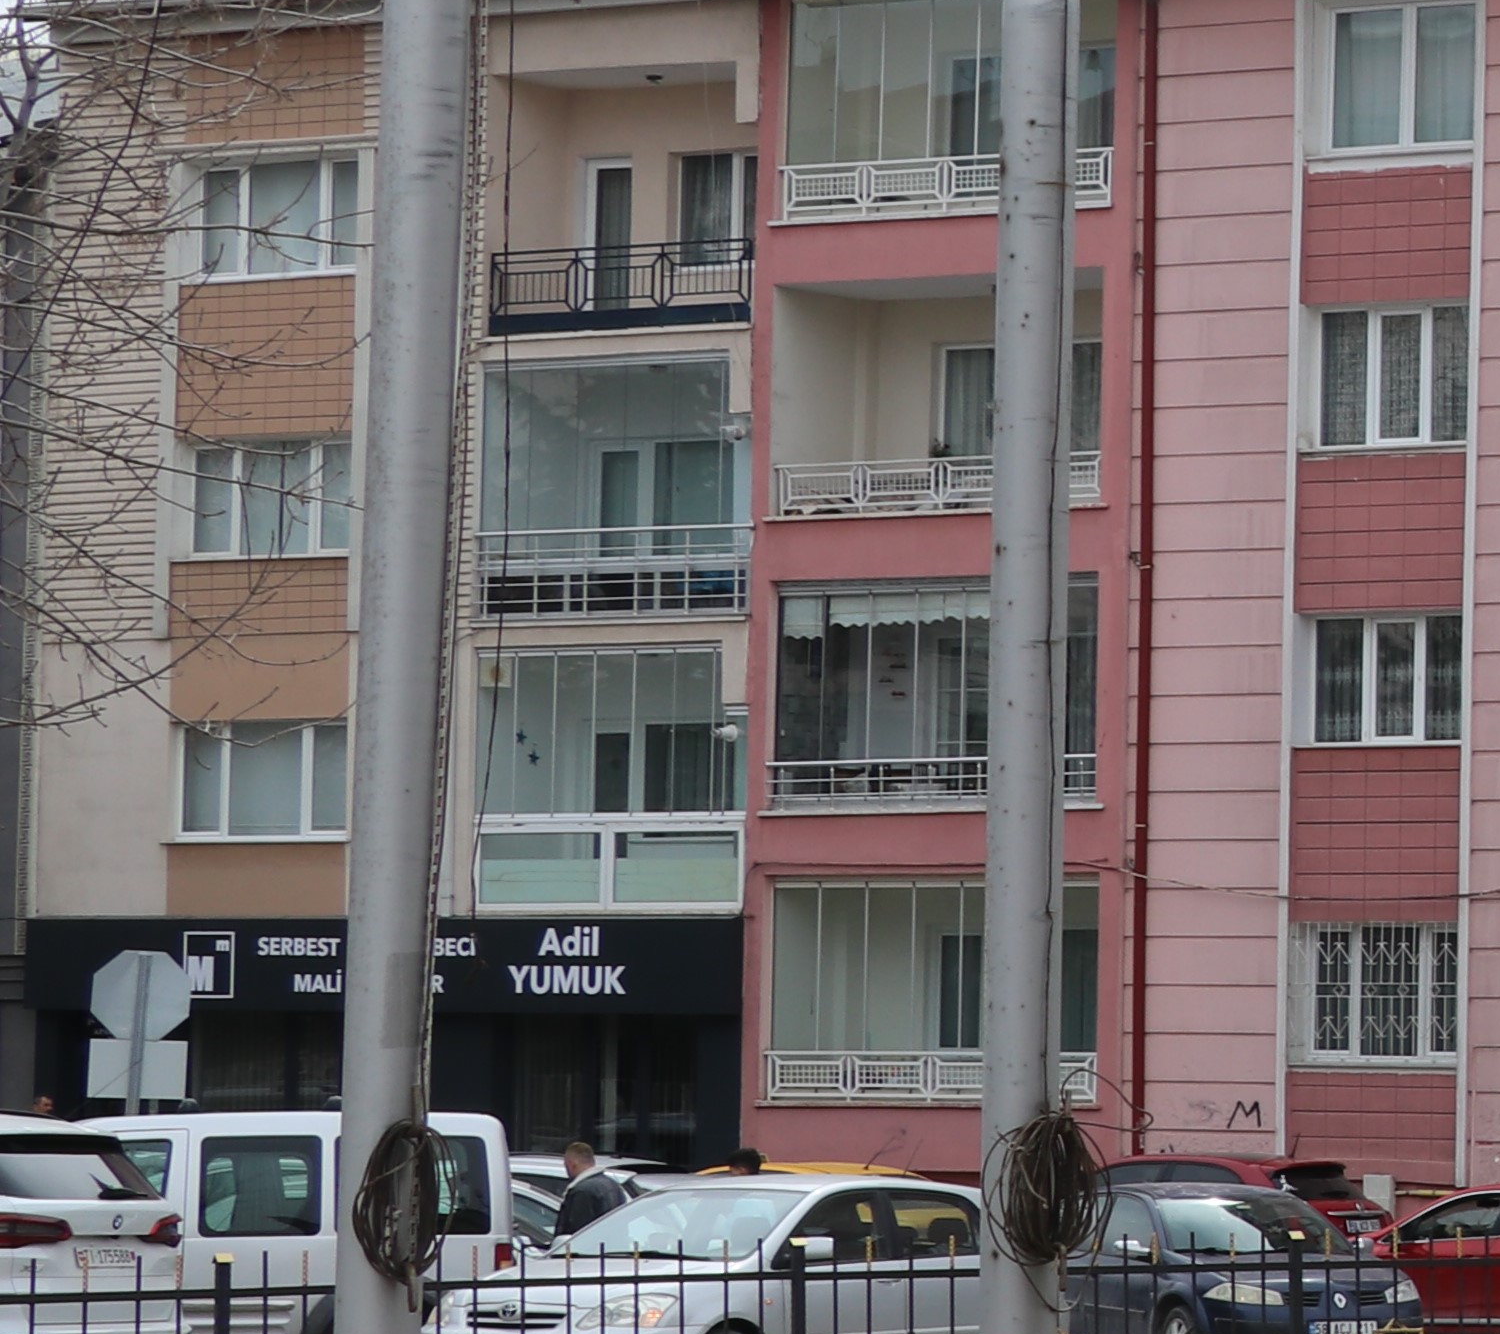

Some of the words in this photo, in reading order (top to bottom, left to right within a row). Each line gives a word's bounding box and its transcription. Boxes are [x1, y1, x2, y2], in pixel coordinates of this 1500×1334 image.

[257, 936, 341, 957] SERBEST
[538, 926, 600, 957] Adil
[293, 969, 342, 993] MALİ
[507, 965, 627, 995] YUMUK
